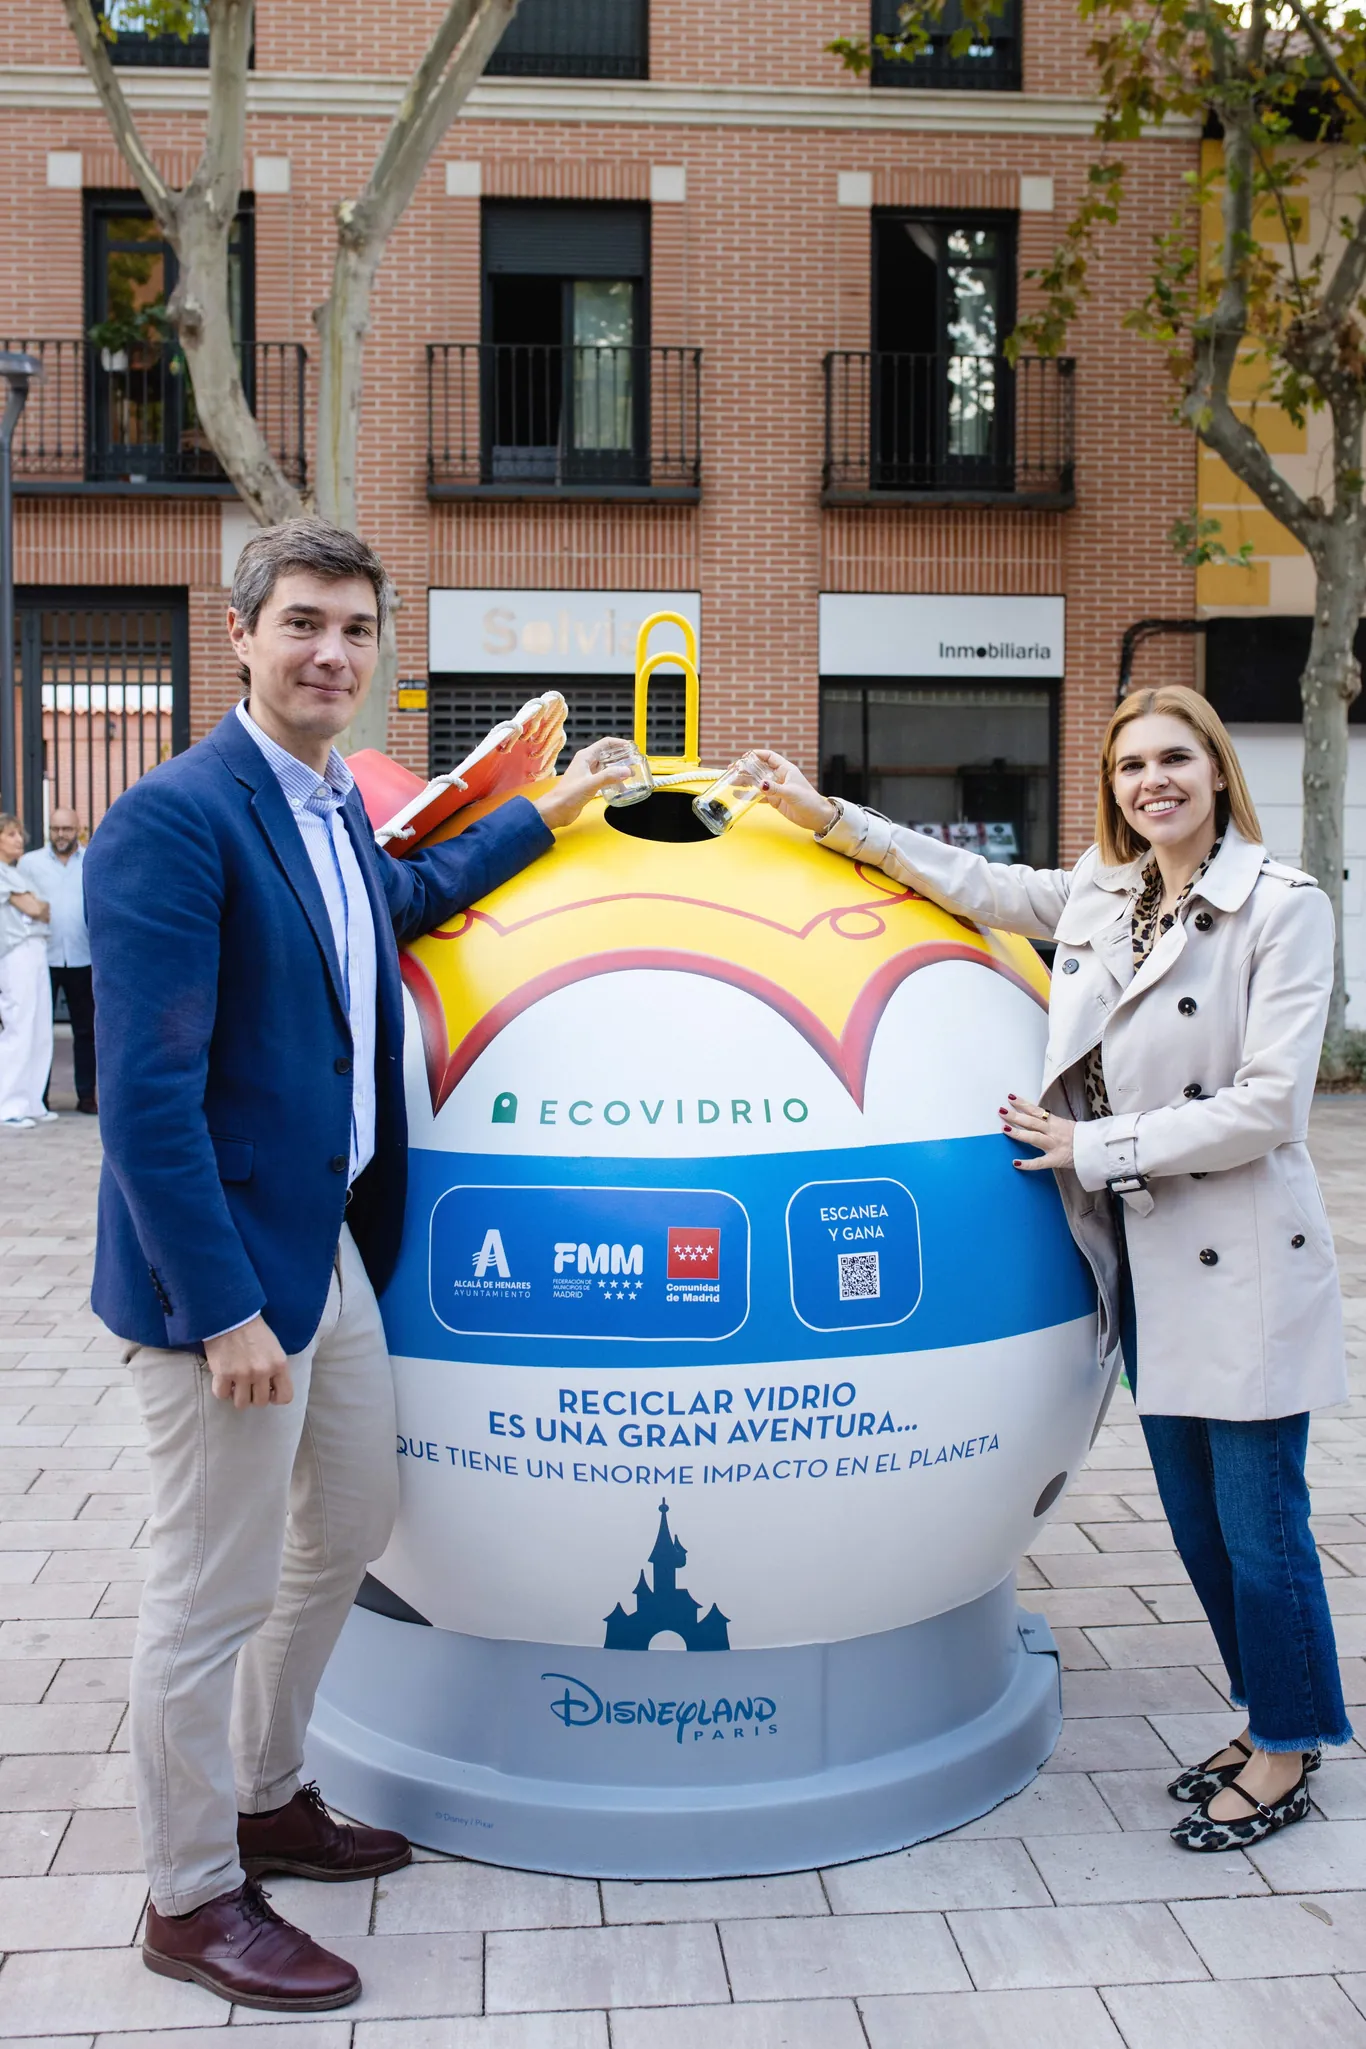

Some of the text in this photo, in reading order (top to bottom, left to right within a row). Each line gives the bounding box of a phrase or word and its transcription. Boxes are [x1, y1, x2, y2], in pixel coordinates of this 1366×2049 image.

[539, 1098, 809, 1125] ECOVIDRIO
[820, 1204, 889, 1221] ESCANEA
[828, 1225, 885, 1241] Y GANA
[554, 1242, 644, 1276] FMM
[453, 1278, 531, 1290] ALCALÁ DE HENARES
[666, 1283, 720, 1292] Comunidad
[453, 1289, 531, 1299] AYUNTAMIENTO
[553, 1290, 583, 1299] MADRID
[666, 1293, 720, 1303] de Madrid
[559, 1382, 856, 1416] RECICLAR VIDRIO
[489, 1410, 918, 1447] ES UNA GRAN AVENTURA...
[396, 1433, 1000, 1485] QUE TIENE UN ENORME IMPACTO EN EL PLANETA
[694, 1724, 779, 1742] PARIS
[443, 1812, 470, 1826] Disney
